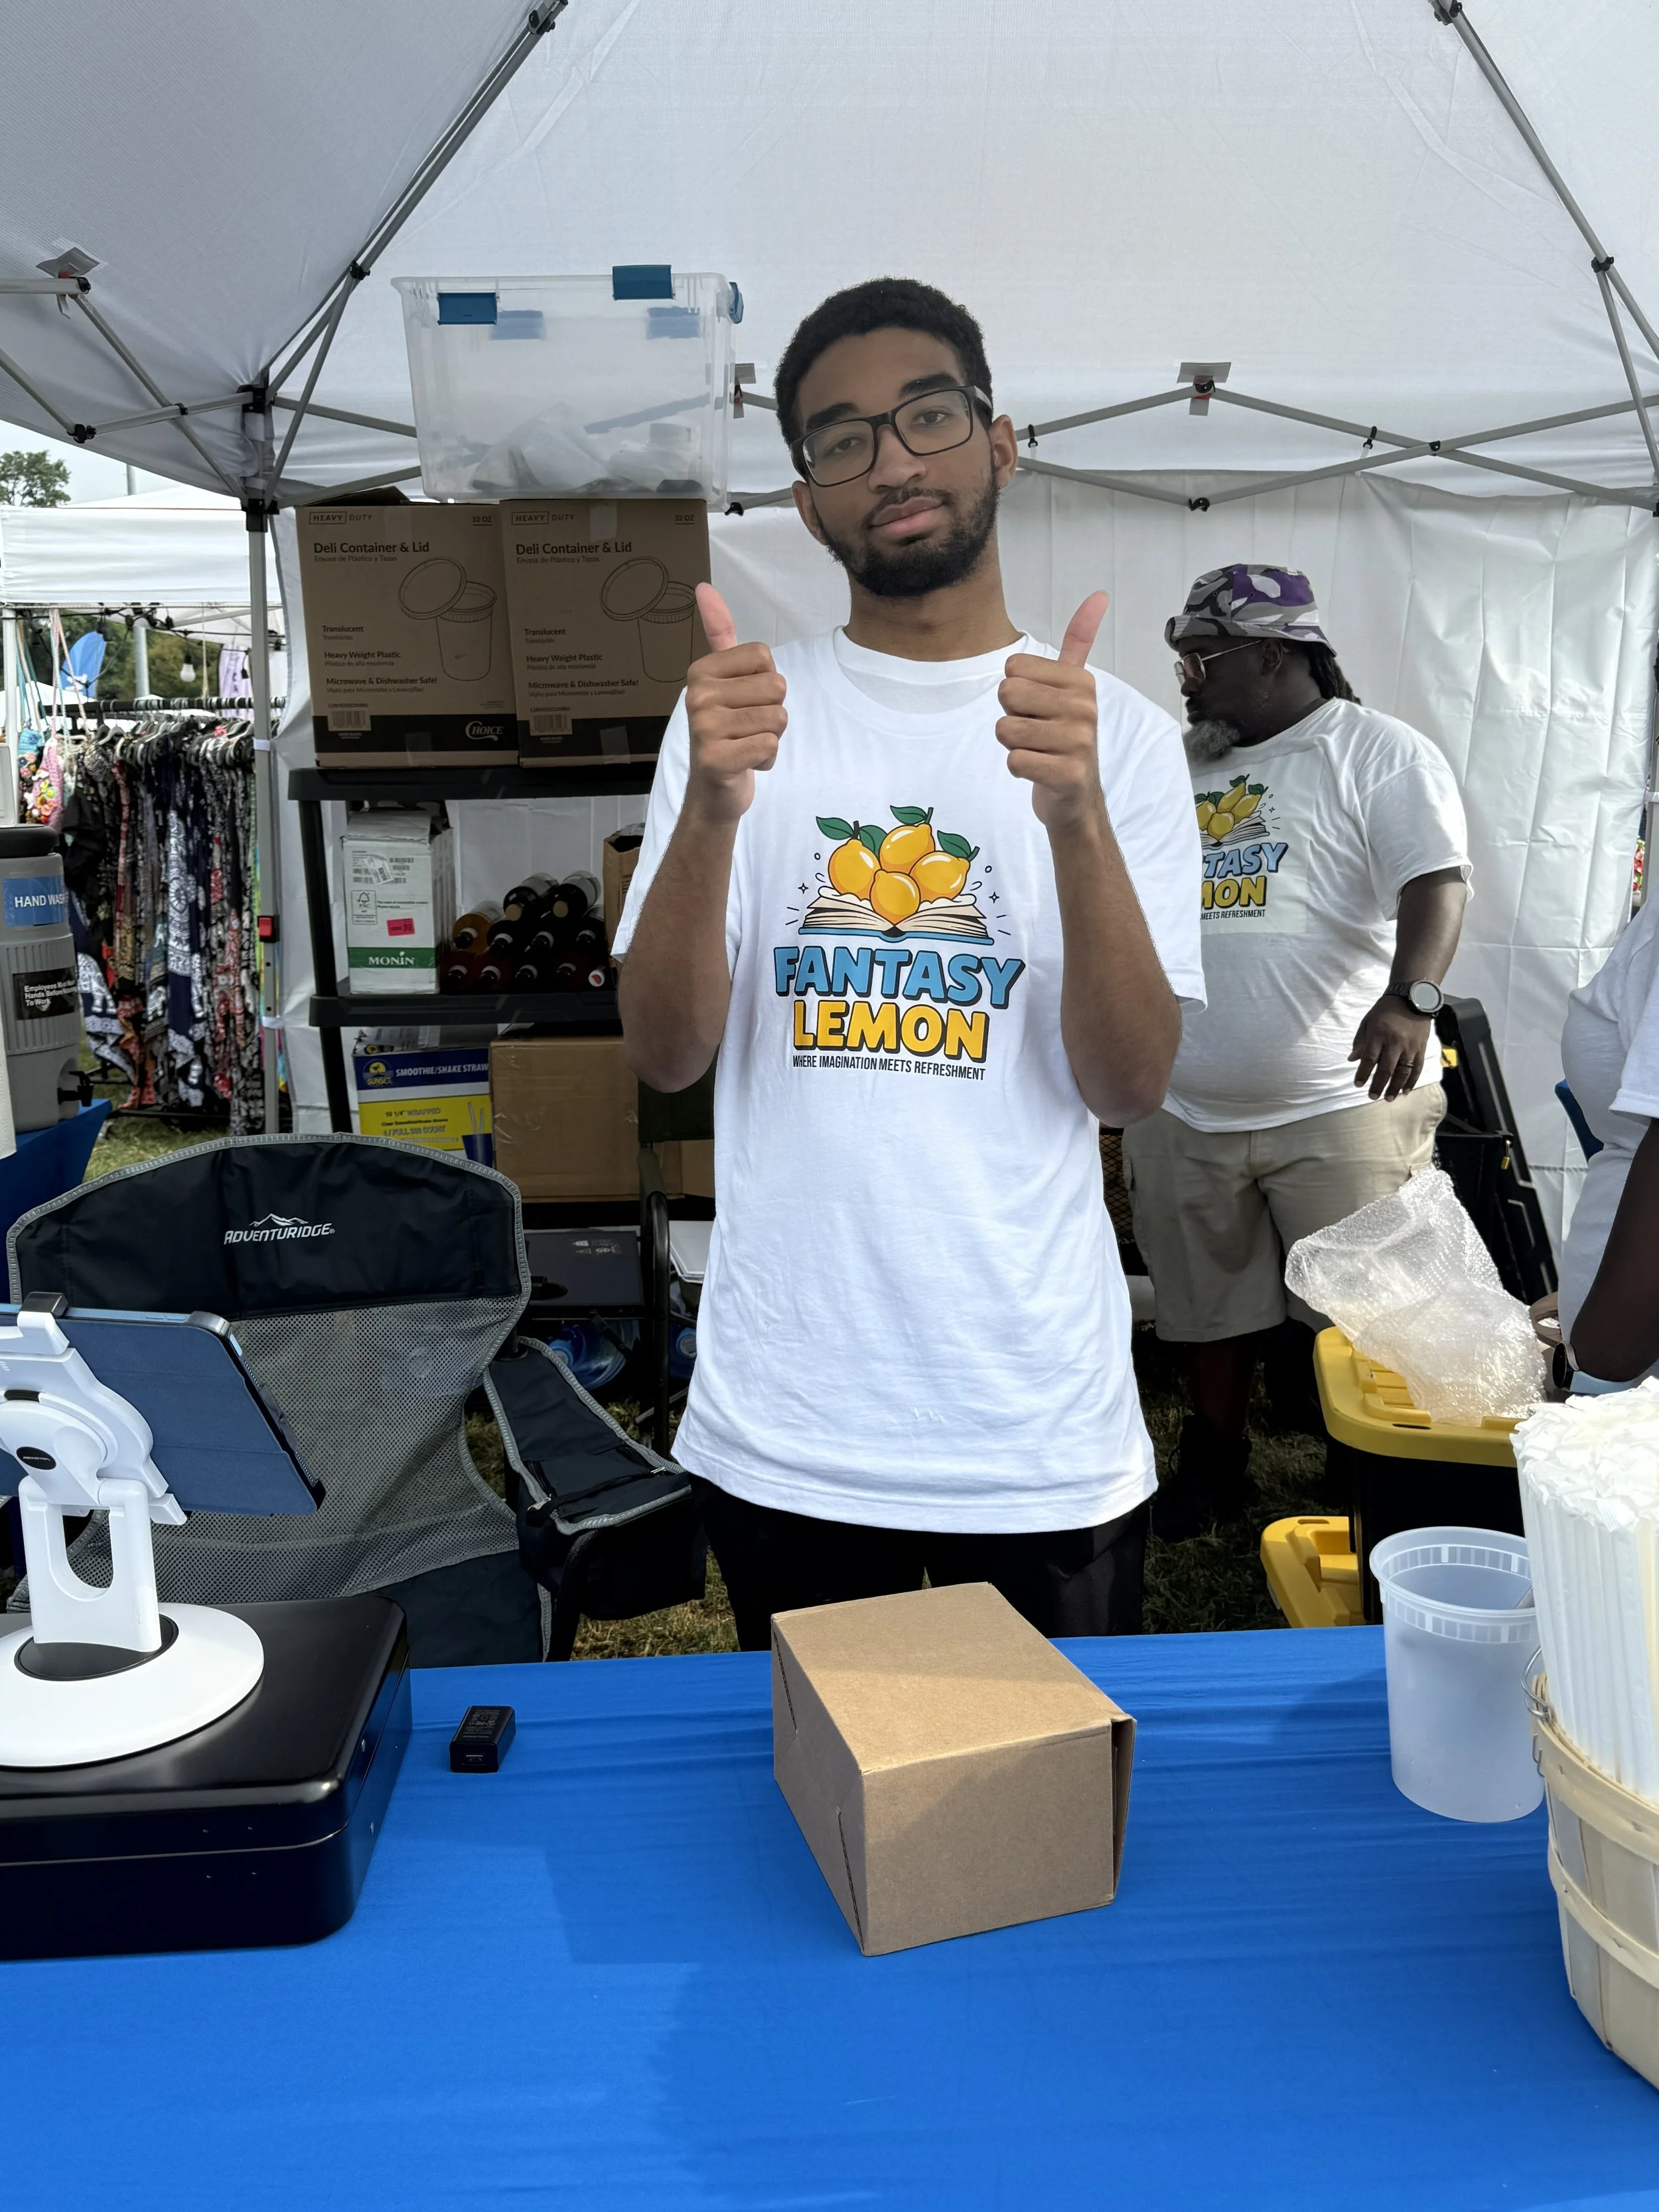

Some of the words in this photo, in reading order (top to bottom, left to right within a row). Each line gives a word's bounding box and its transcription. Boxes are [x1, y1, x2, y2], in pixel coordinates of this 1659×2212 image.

[314, 542, 336, 553] Deli
[340, 542, 397, 553] Container
[400, 542, 409, 552] &
[412, 542, 430, 553] Lid
[516, 544, 539, 555] Deli
[543, 543, 601, 554] Container
[603, 542, 611, 553] &
[614, 542, 632, 552] Lid
[465, 721, 504, 741] CHOICE
[1202, 843, 1289, 878] TASY
[15, 895, 46, 908] HAND
[1200, 911, 1220, 921] MEETS
[1220, 909, 1266, 919] REFRESHMENT
[368, 951, 415, 966] MONIN
[774, 946, 1025, 1009] FANTASY
[24, 984, 56, 992] Employees
[794, 999, 989, 1063] LEMON
[395, 1065, 463, 1077] SMOOTHIE/SHAKE
[792, 1055, 817, 1068] WHERE
[819, 1055, 877, 1070] IMAGINATION
[879, 1059, 912, 1073] MEETS
[914, 1061, 986, 1081] REFRESHMENT
